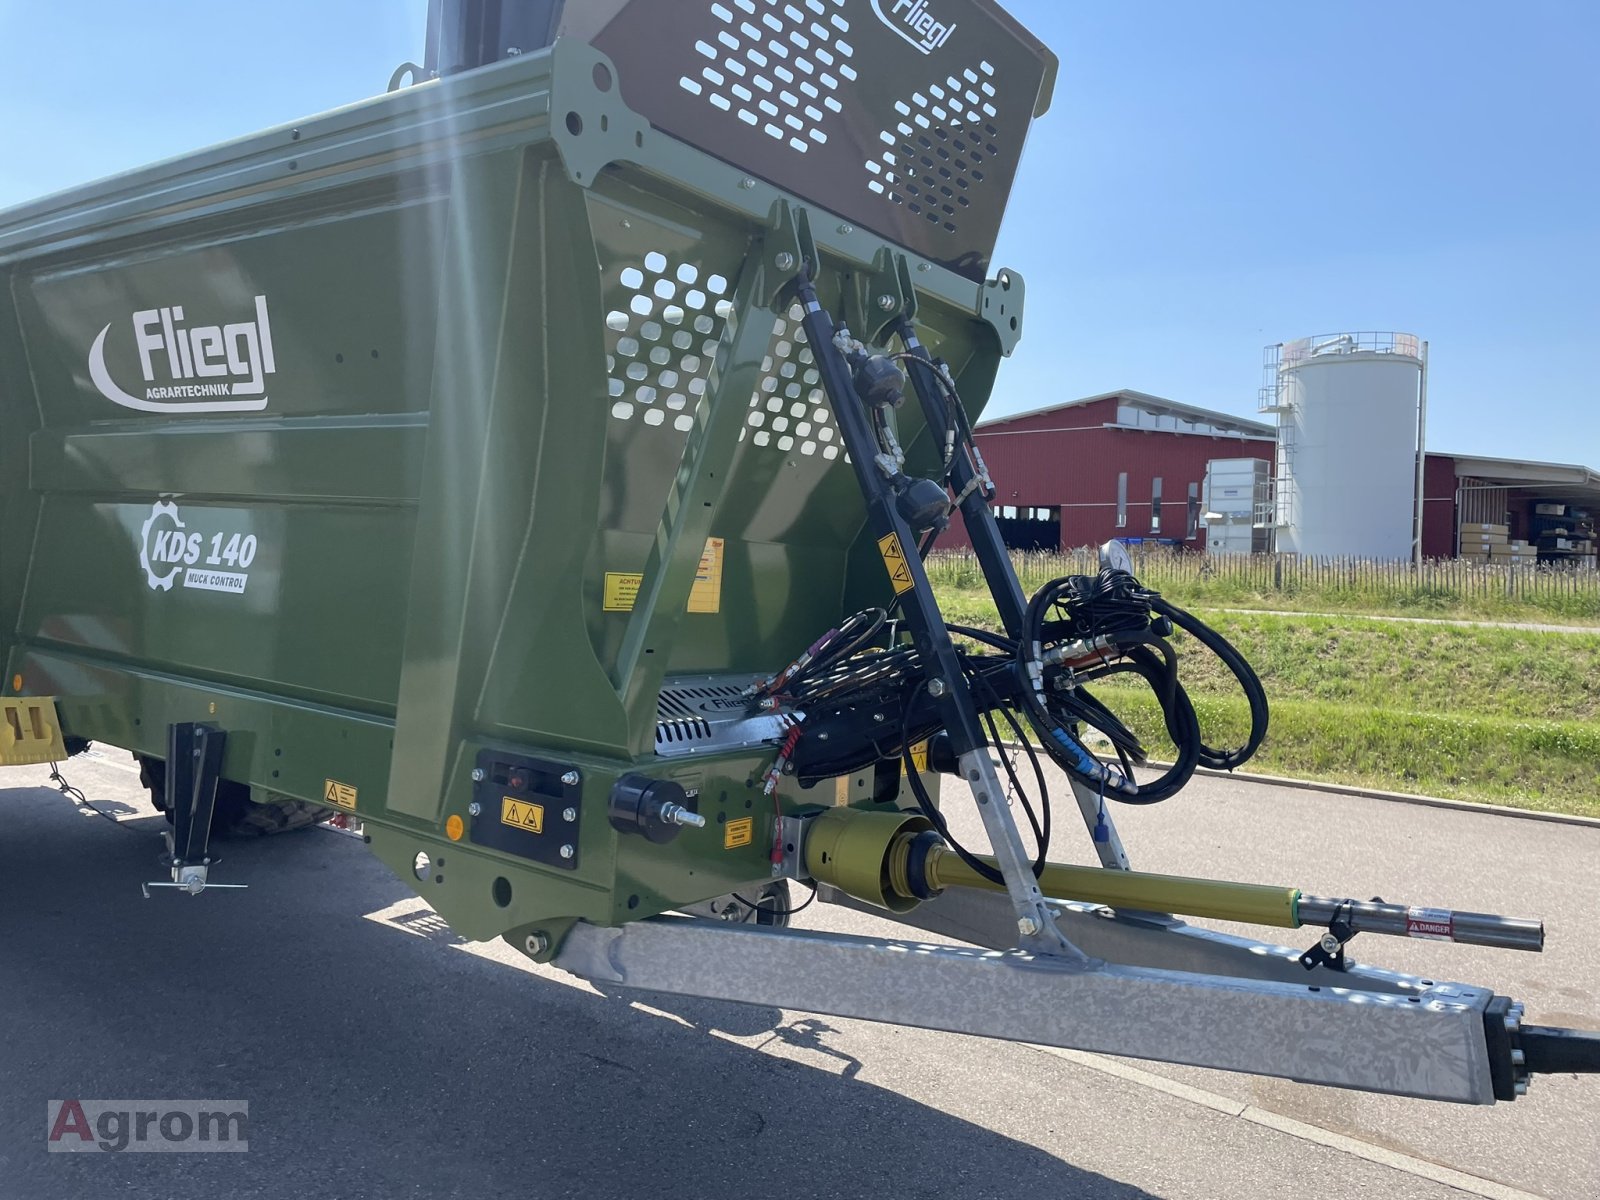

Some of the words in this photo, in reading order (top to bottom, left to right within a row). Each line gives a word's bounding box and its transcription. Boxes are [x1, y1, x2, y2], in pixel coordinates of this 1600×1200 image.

[132, 295, 276, 395] Fliegl
[146, 383, 230, 399] AGRARTECHNIK
[152, 530, 203, 565] KDS
[206, 532, 257, 568] 140
[188, 572, 208, 585] MUCK
[210, 575, 243, 588] CONTROL
[1420, 923, 1450, 934] DANGER
